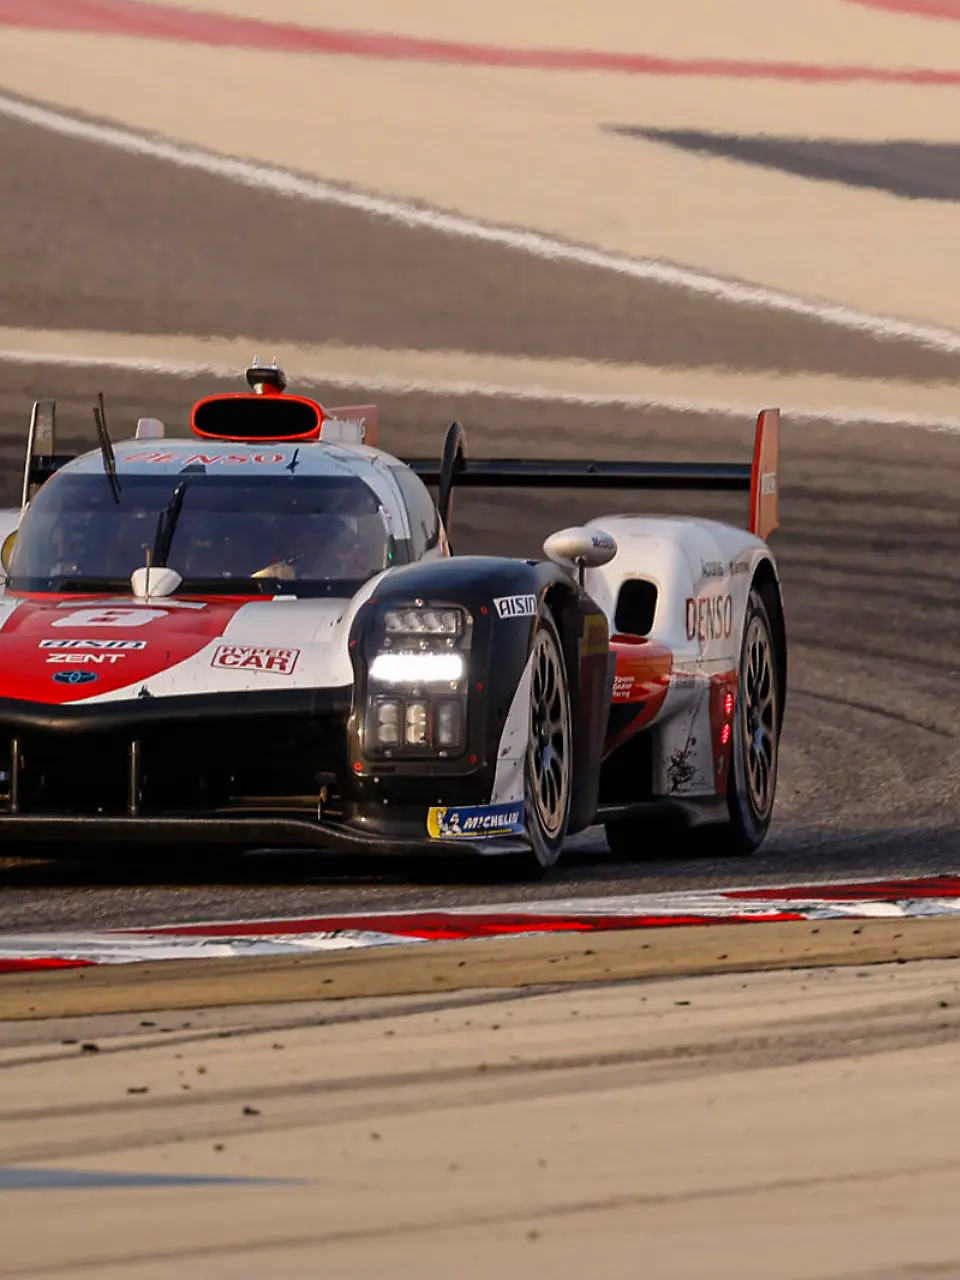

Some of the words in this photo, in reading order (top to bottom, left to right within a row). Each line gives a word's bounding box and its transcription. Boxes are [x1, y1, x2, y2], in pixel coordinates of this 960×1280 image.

[51, 608, 169, 627] 8
[685, 595, 732, 642] DENSO
[46, 653, 125, 664] ZENT
[221, 645, 293, 658] HYPER
[218, 654, 290, 671] CAR
[463, 812, 520, 830] MICHELIN
